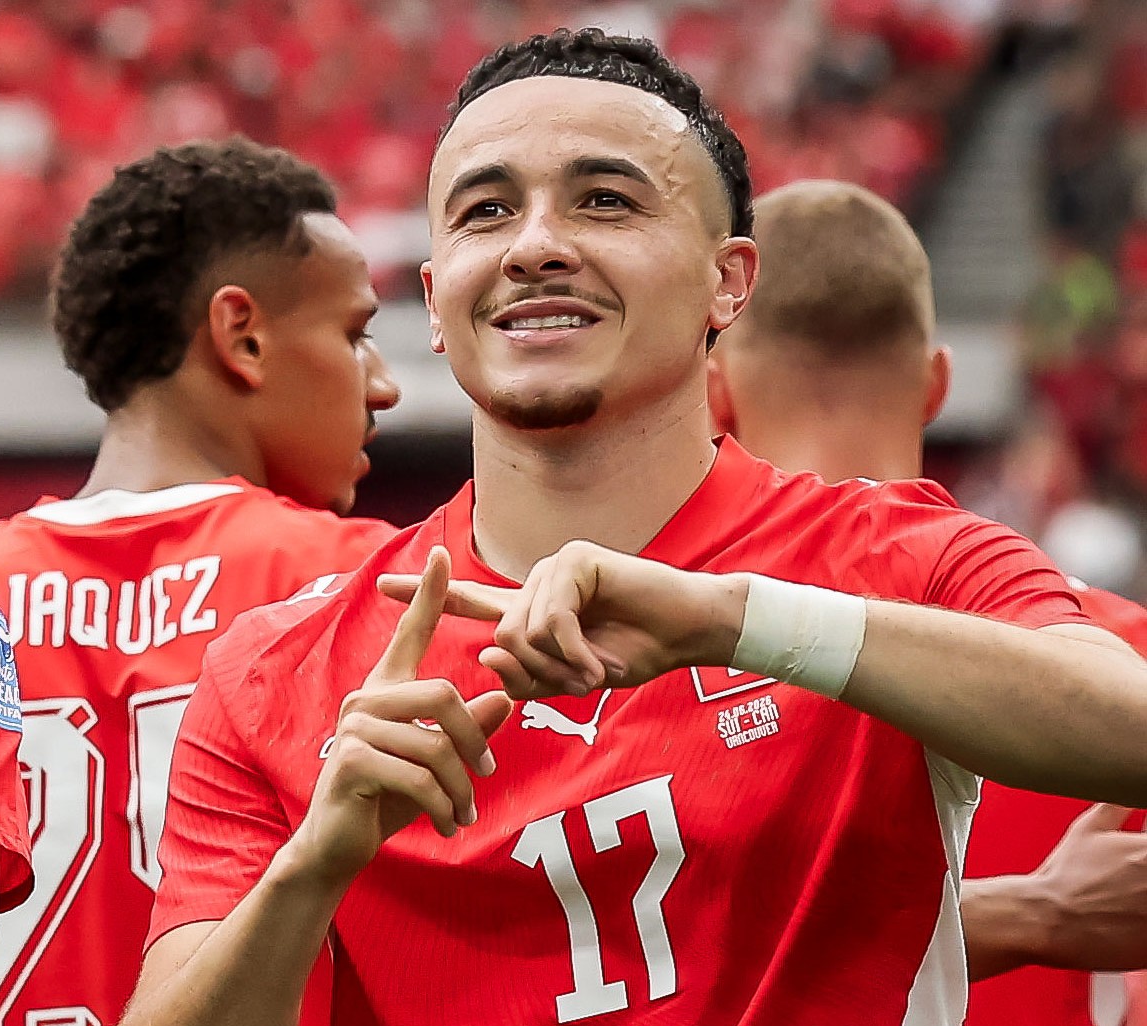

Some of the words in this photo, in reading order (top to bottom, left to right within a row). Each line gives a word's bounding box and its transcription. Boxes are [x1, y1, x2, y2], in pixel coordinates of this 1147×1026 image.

[9, 554, 222, 655] JAQUEZ
[717, 717, 741, 738] SUI
[751, 703, 779, 725] CAN
[725, 721, 779, 749] VANCOUVER
[510, 773, 686, 1023] 17
